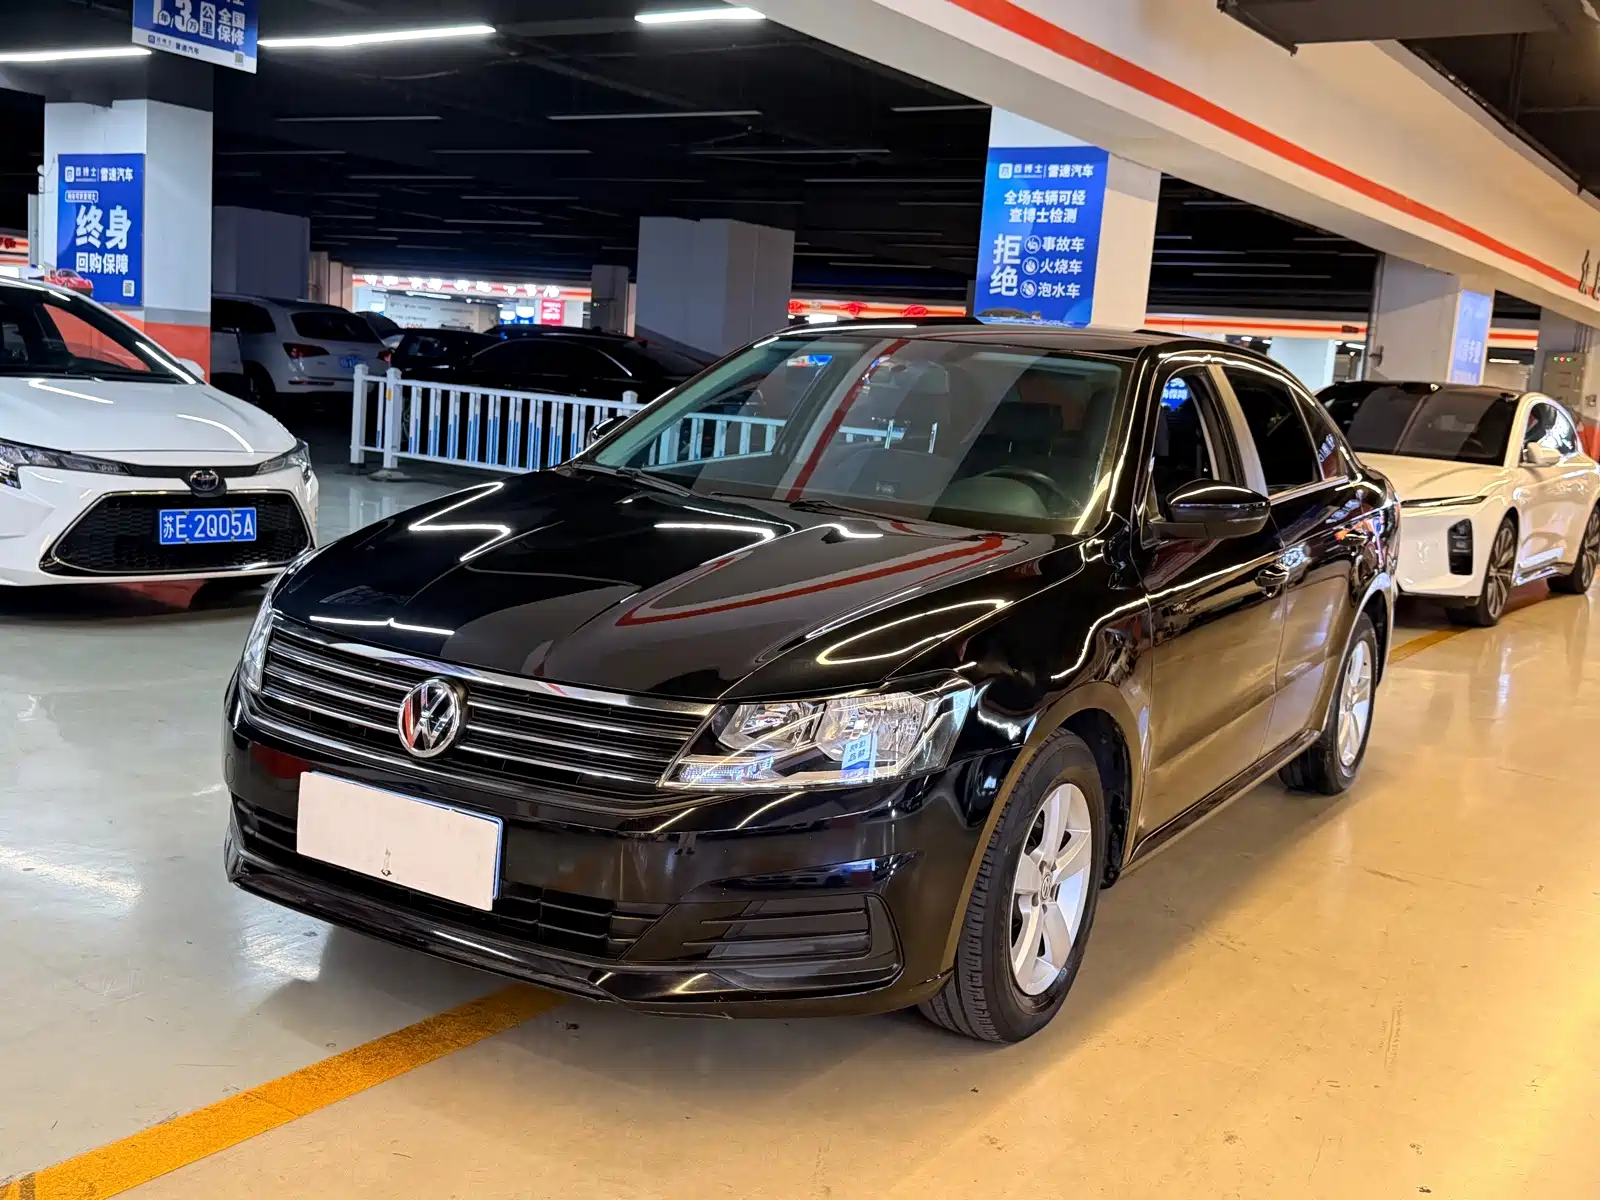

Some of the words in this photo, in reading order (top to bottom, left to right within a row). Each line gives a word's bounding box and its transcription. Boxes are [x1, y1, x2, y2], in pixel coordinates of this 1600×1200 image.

[217, 24, 245, 46] 保修
[1004, 189, 1086, 205] 全场车辆可经
[1009, 207, 1078, 223] 查博士检测
[76, 205, 132, 250] 终身
[1042, 236, 1085, 252] 事故车
[76, 252, 129, 275] 回购保障
[989, 233, 1023, 296] 拒绝
[1040, 258, 1083, 275] 火烧车
[1038, 282, 1081, 298] 泡水车
